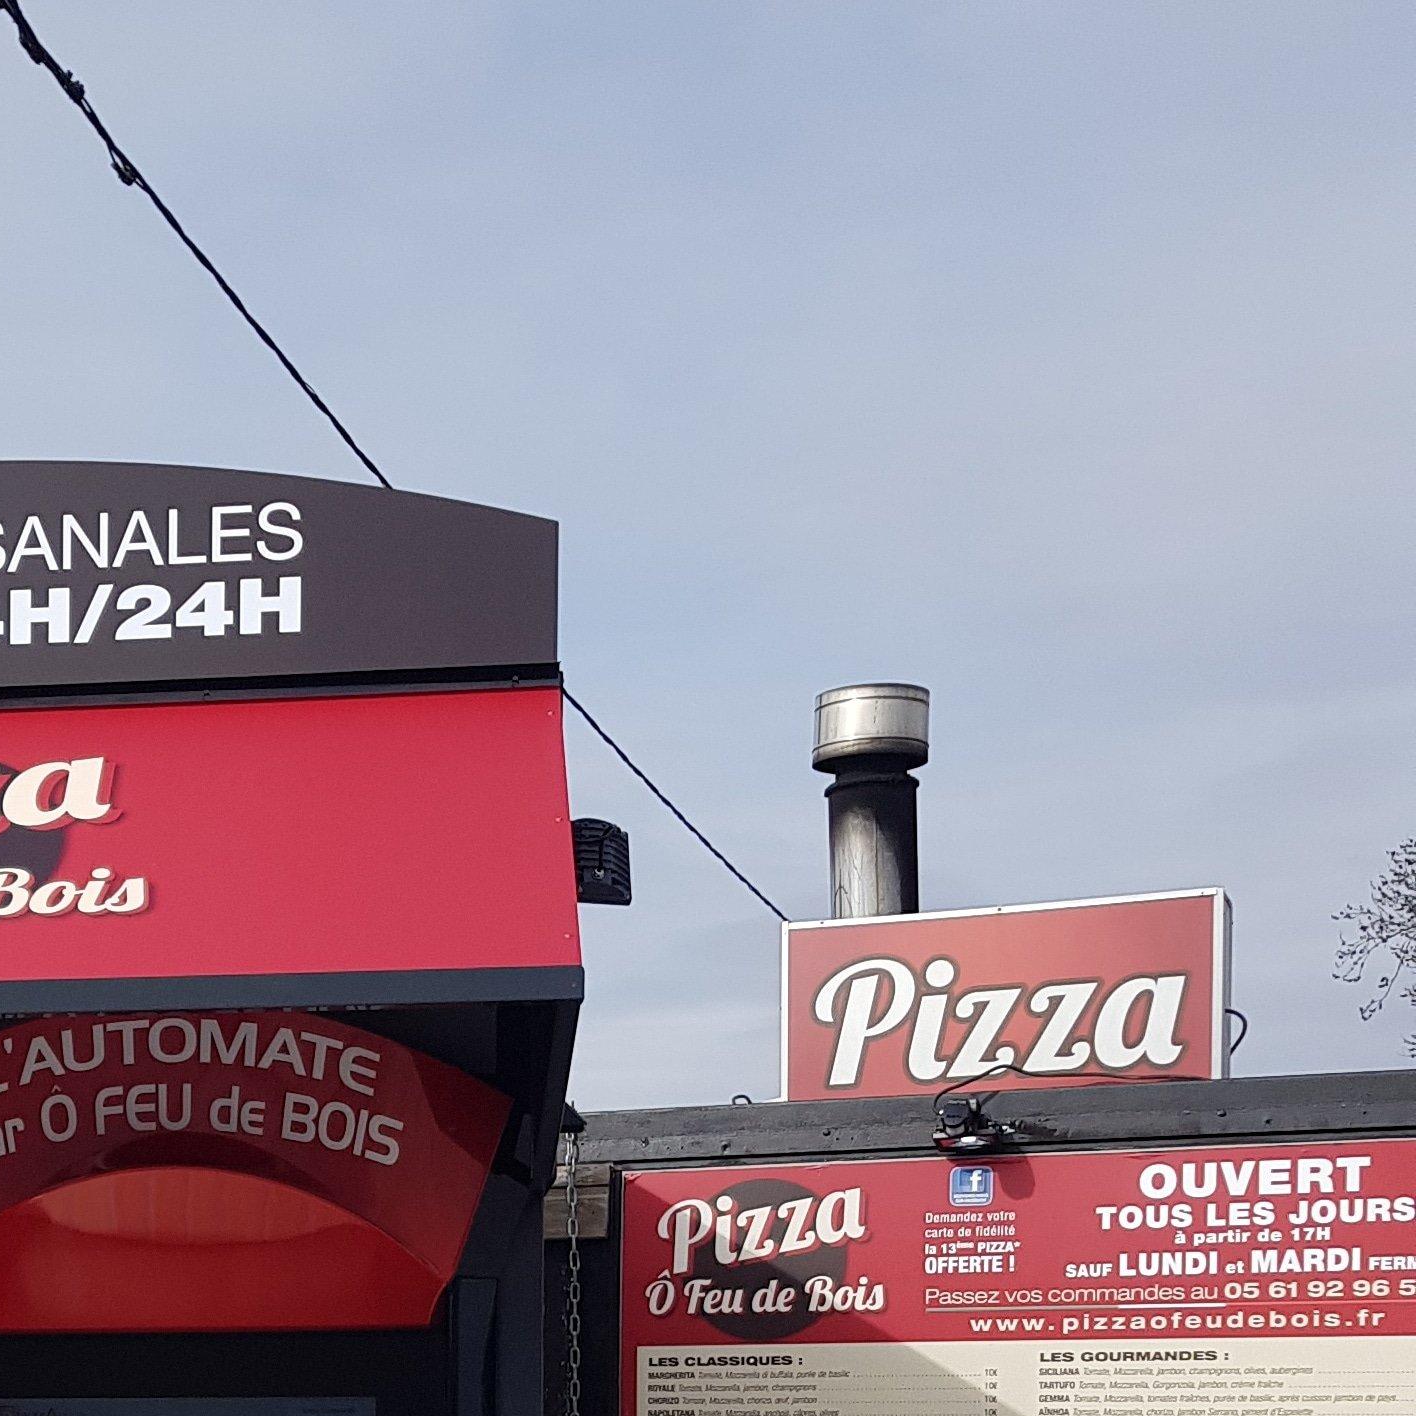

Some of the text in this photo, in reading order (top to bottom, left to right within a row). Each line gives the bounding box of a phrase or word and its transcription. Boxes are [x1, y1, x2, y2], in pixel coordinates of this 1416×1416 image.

[814, 957, 1187, 1087] Pizza
[40, 1086, 78, 1143] Ô
[95, 1082, 193, 1137] FEU
[209, 1084, 267, 1136] de
[284, 1091, 407, 1167] BOIS
[1139, 1156, 1372, 1200] OUVERT
[925, 1211, 1016, 1224] Demandez votre
[1096, 1196, 1416, 1231] TOUS LES JOURS
[658, 1186, 868, 1276] Pizza
[924, 1225, 1016, 1238] carte de fidélité
[1174, 1226, 1332, 1247] à partir de 17H
[924, 1243, 937, 1255] la
[924, 1254, 1016, 1274] OFFERTE !
[1065, 1262, 1112, 1278] SAUF
[1119, 1251, 1218, 1278] LUNDI
[1225, 1259, 1245, 1275] et
[1251, 1247, 1362, 1274] MARDI
[645, 1273, 885, 1316] Ô Feu de Bois
[925, 1288, 1000, 1305] Passez
[1004, 1289, 1044, 1304] vos
[1048, 1284, 1186, 1304] commandes
[1190, 1286, 1219, 1301] au
[1224, 1281, 1260, 1300] 05
[1268, 1281, 1298, 1299] 61
[1307, 1279, 1345, 1298] 92
[1352, 1279, 1391, 1297] 96
[969, 1308, 1386, 1334] www.pizzaofeudebois.fr
[648, 1355, 793, 1367] LES CLASSIQUES
[1040, 1350, 1218, 1363] LES GOURMANDES
